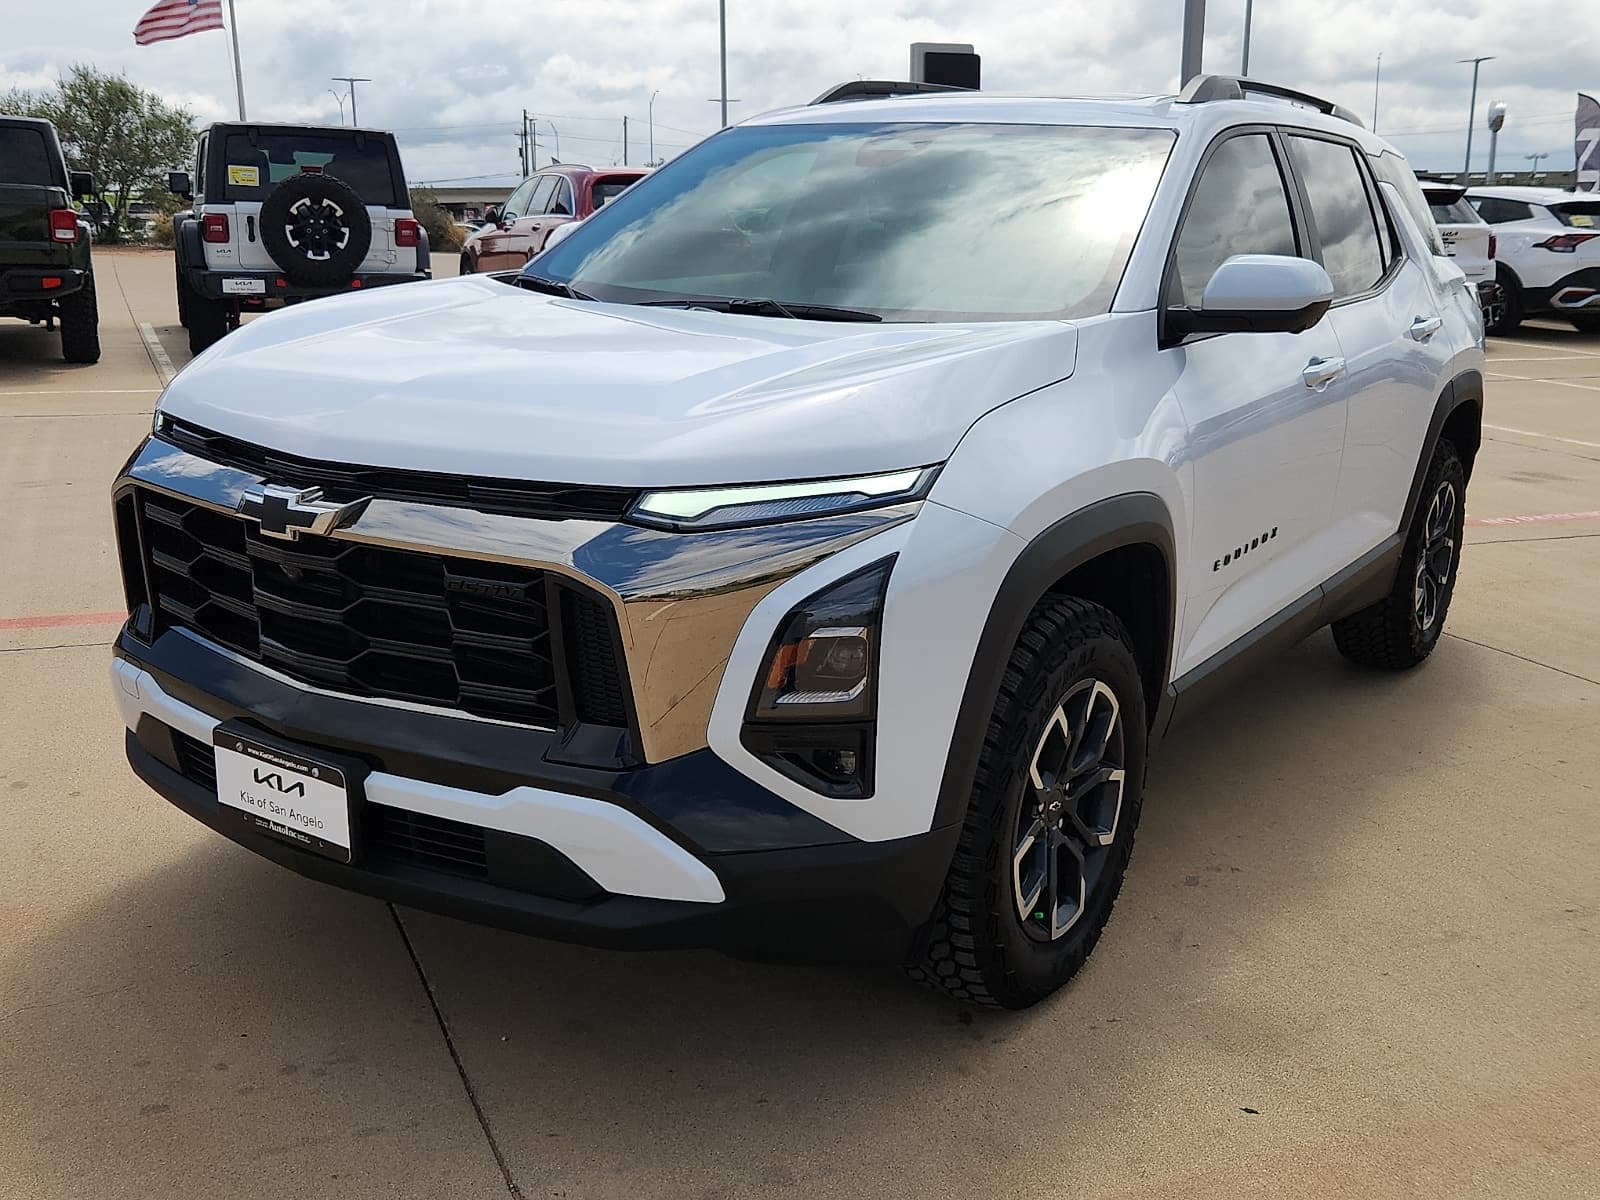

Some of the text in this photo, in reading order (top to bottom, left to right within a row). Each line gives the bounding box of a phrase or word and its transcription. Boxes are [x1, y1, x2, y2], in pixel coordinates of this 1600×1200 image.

[1212, 526, 1278, 572] EQUINOX
[253, 767, 305, 798] KIA
[240, 789, 325, 830] Kia of San Angelo
